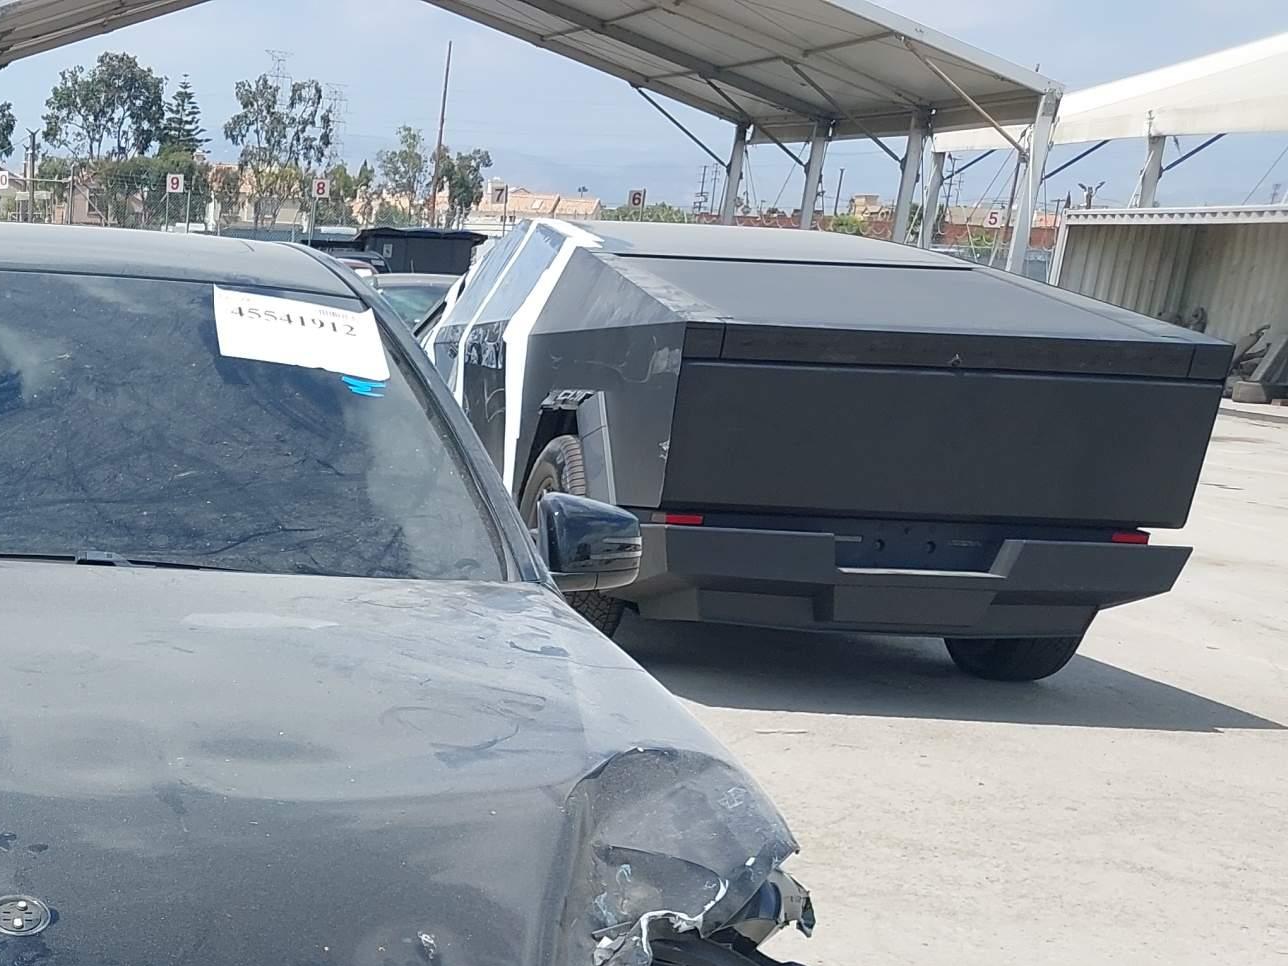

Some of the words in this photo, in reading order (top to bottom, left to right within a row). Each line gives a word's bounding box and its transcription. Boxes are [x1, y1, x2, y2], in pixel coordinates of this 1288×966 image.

[170, 176, 180, 190] 9
[316, 181, 326, 195] 8
[495, 188, 504, 202] 7
[632, 191, 642, 206] 6
[988, 211, 998, 226] 5
[231, 305, 358, 337] 45541912
